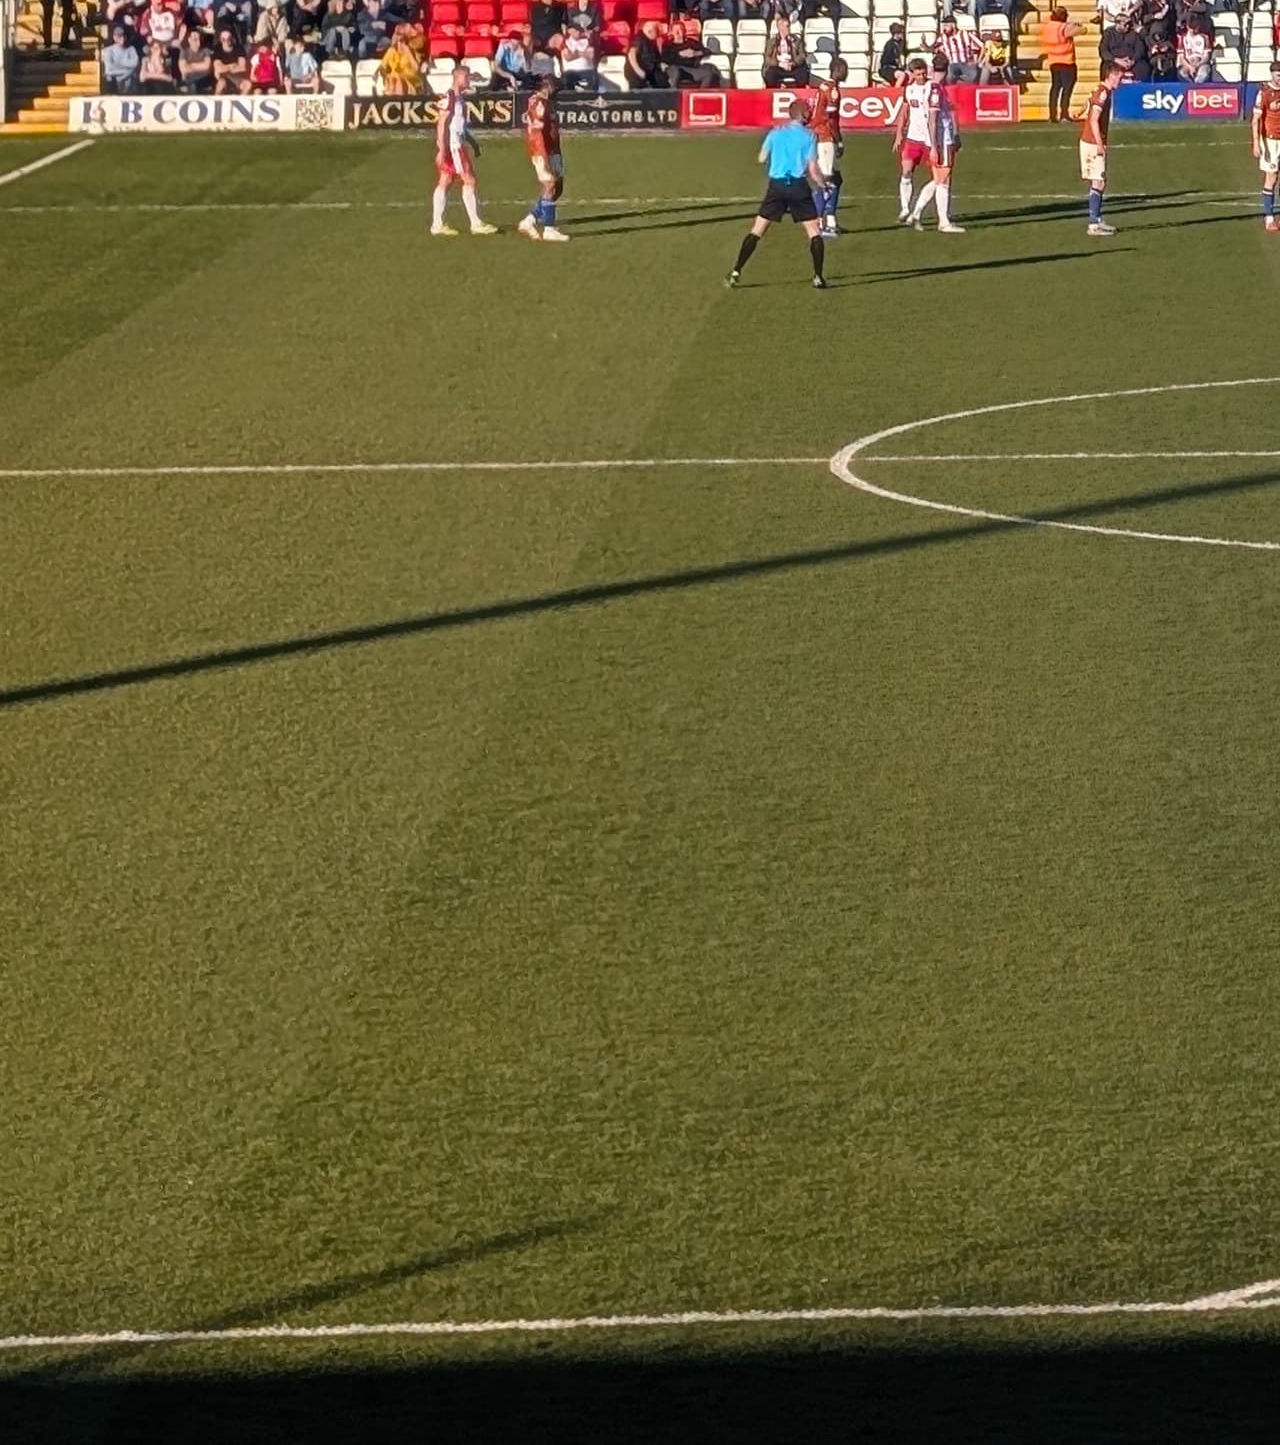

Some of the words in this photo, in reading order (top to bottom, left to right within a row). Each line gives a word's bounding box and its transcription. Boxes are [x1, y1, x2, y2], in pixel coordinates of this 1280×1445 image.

[120, 100, 143, 124] B
[153, 98, 281, 124] COINS
[348, 99, 513, 130] JACKSN'S
[1141, 89, 1185, 115] sky
[1192, 87, 1232, 109] bet
[647, 109, 678, 123] LTD
